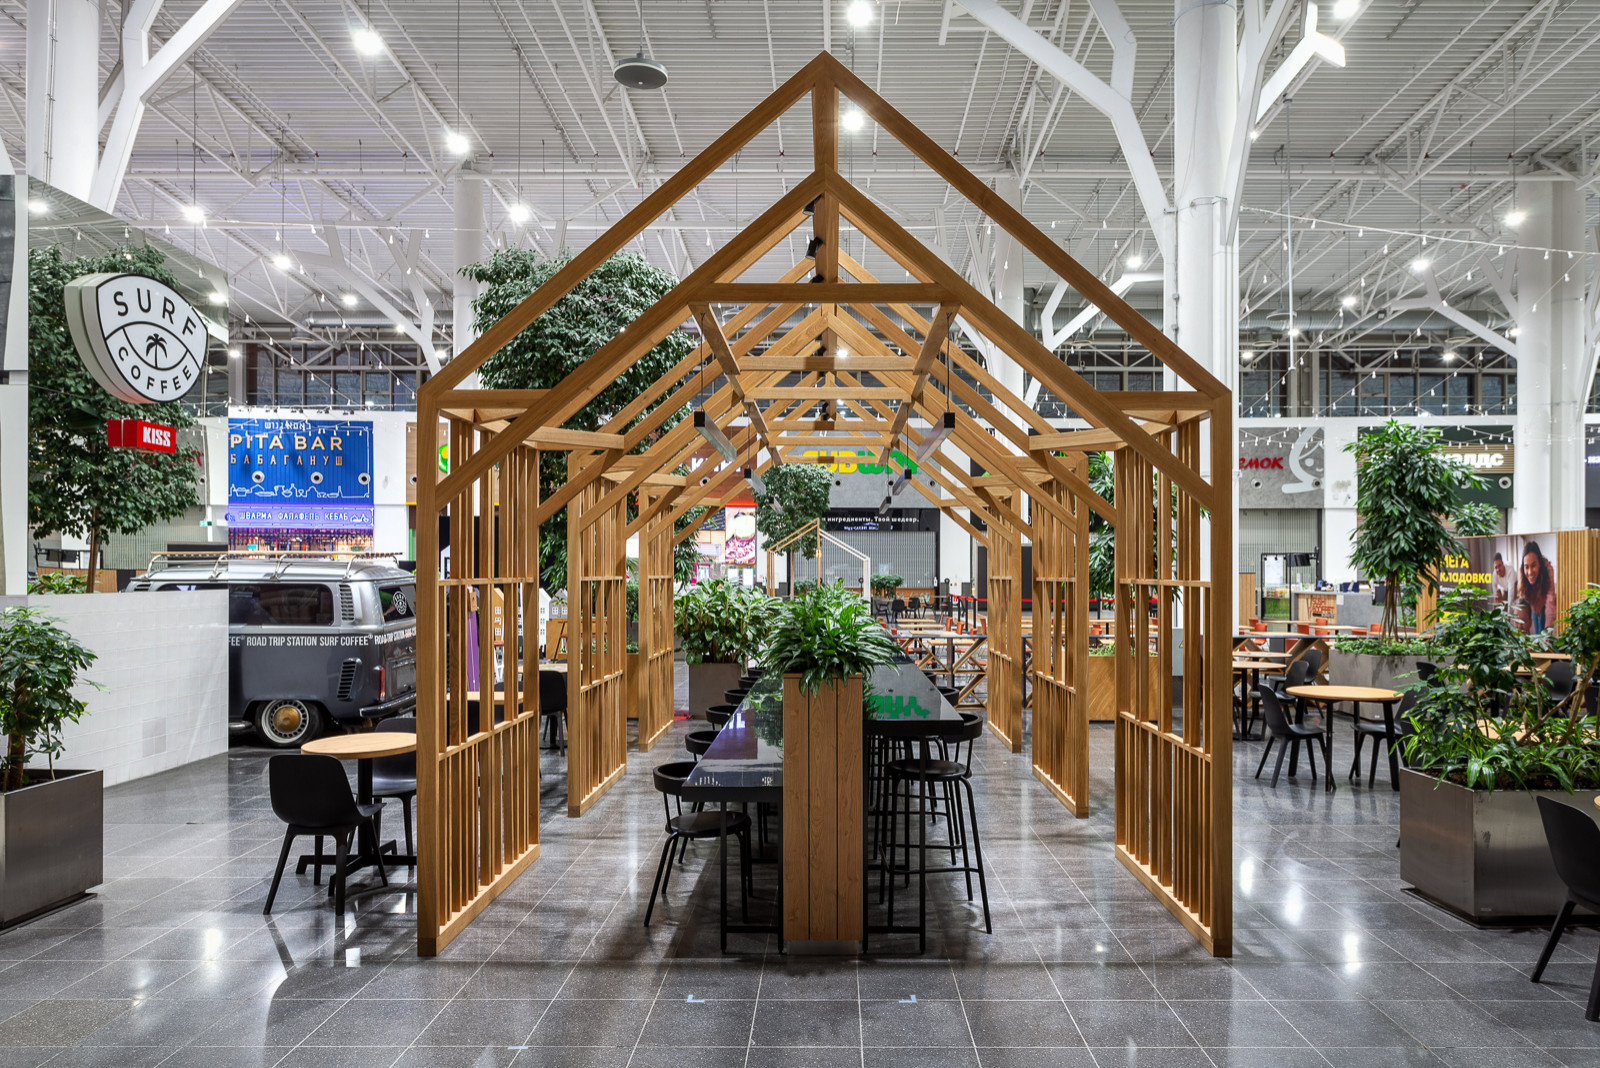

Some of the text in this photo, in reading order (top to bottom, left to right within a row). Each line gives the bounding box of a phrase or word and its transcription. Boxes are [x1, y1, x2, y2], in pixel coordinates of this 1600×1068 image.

[113, 288, 196, 336] SURF
[118, 346, 192, 394] COFFEE
[143, 426, 171, 447] KISS
[230, 434, 343, 451] PITA BAR
[230, 454, 343, 466] БАБАГАНУШ
[238, 511, 272, 520] ШВАРМА
[324, 513, 348, 521] КЕБАБ
[246, 636, 267, 647] ROAD
[268, 636, 285, 647] TRIP
[286, 636, 317, 647] STATION
[319, 635, 339, 646] SURF
